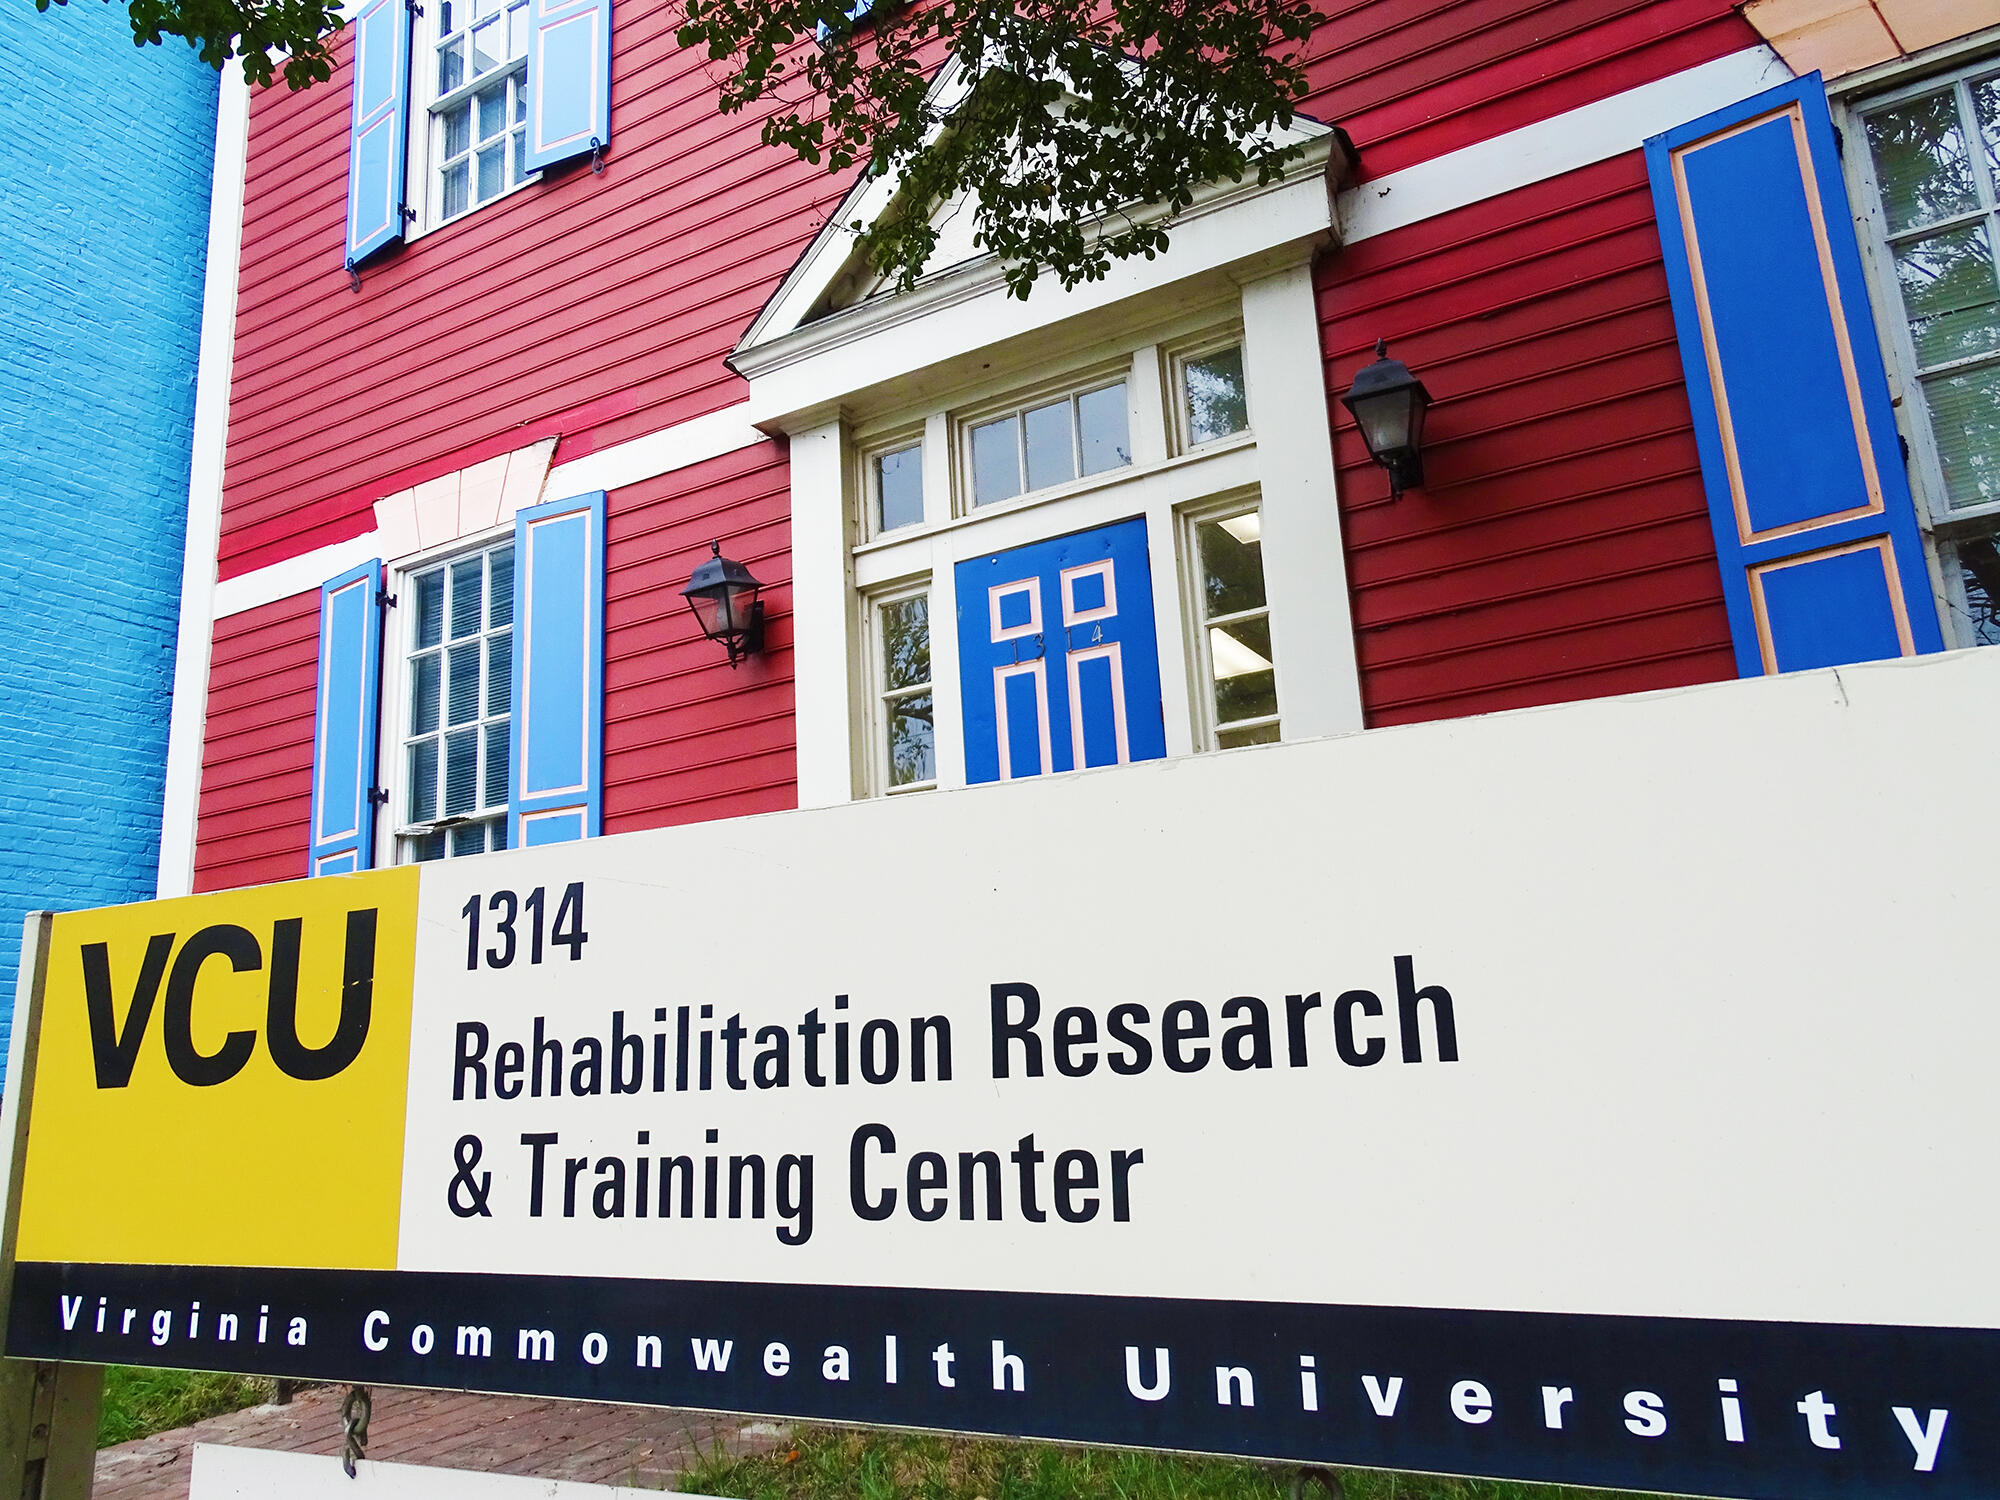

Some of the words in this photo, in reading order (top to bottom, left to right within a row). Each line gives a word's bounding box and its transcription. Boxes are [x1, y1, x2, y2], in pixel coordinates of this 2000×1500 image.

[1010, 620, 1105, 664] 1314
[461, 881, 589, 971] 1314
[81, 907, 378, 1090] VCU
[452, 994, 953, 1101] Rehabilitation
[990, 954, 1459, 1079] Research
[447, 1134, 493, 1218] &
[520, 1128, 814, 1246] Training
[849, 1123, 1144, 1224] Center
[59, 1294, 309, 1346] Virginia
[363, 1309, 1026, 1392] Commonwealth
[1125, 1346, 1949, 1473] University
